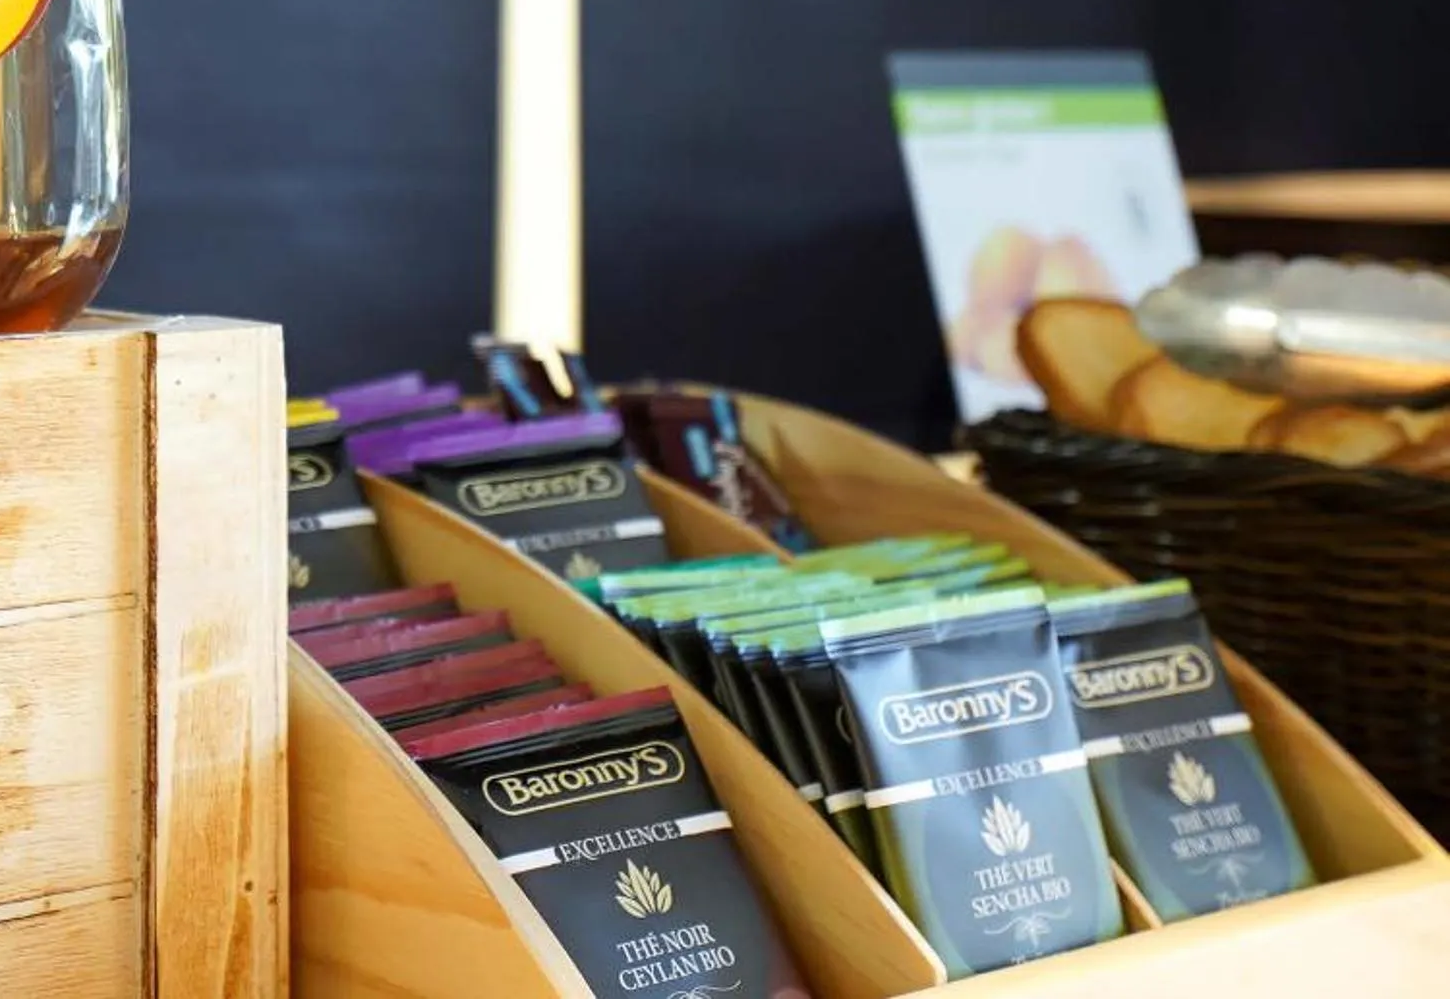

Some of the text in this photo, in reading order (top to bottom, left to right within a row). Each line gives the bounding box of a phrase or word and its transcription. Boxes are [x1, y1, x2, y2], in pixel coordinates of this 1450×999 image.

[935, 756, 1044, 796] EXCELLENCE
[559, 821, 681, 862] EXCELLENCE
[974, 853, 1056, 891] THÉ VERT
[971, 877, 1072, 918] SENCHA BIO
[617, 924, 716, 965] THÉ NOIR
[619, 946, 736, 991] CEYLAN BIO
